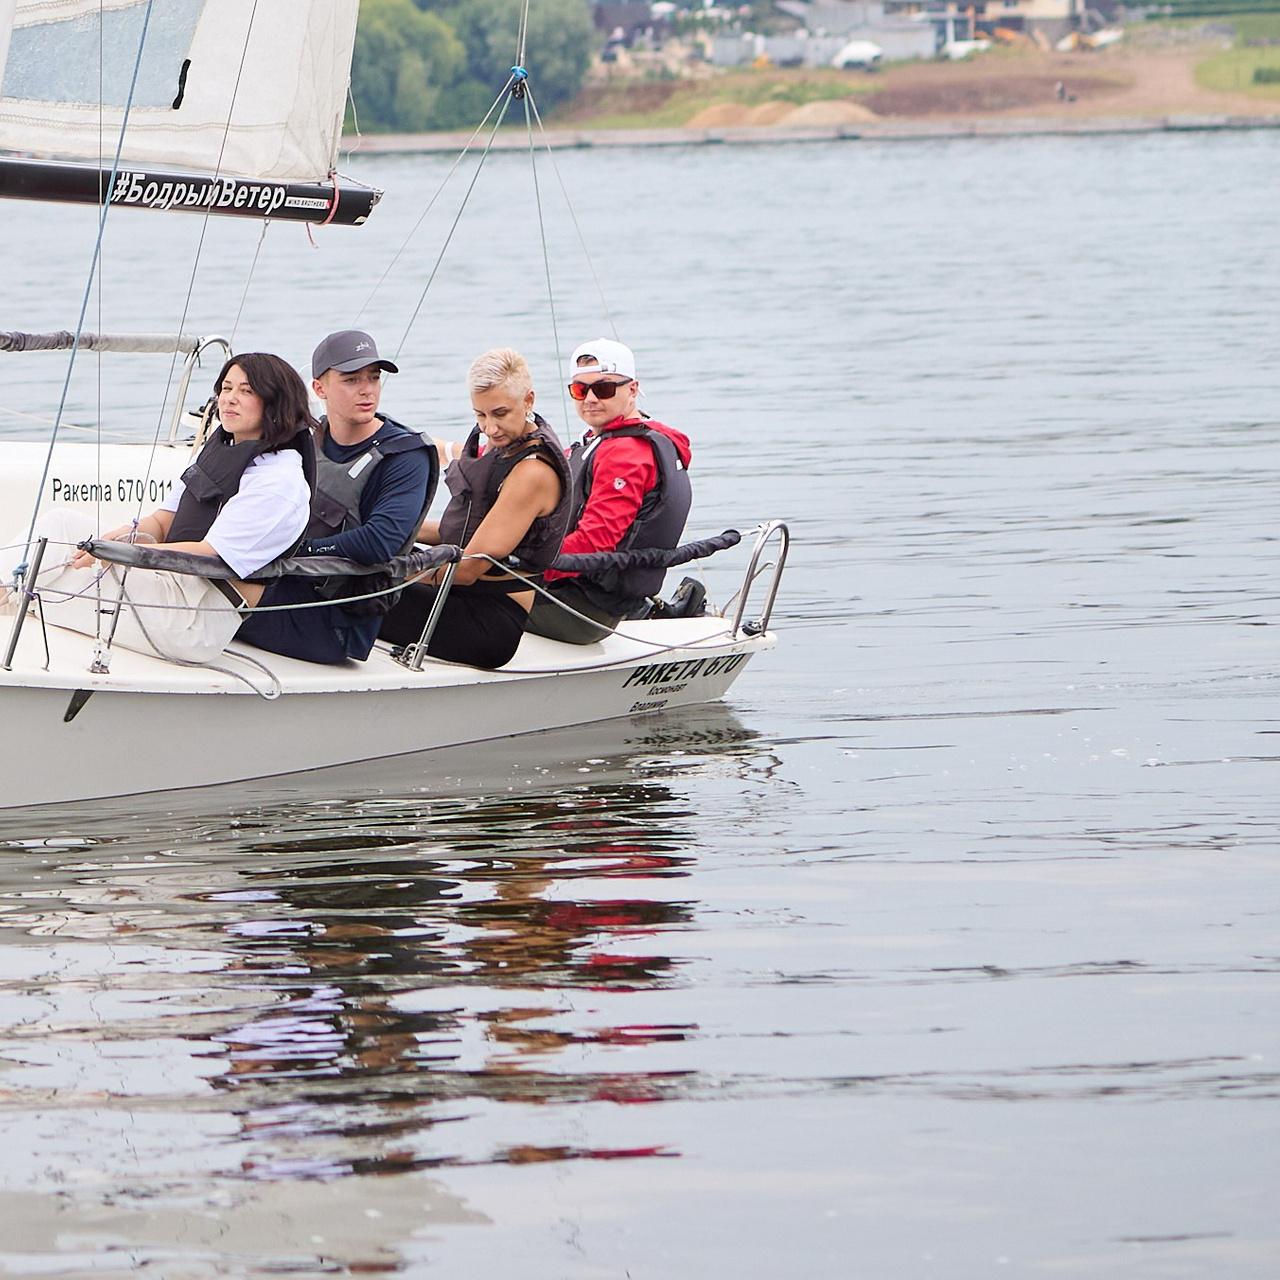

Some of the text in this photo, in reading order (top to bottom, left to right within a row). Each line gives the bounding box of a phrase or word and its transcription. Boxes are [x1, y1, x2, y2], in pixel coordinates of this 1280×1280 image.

[118, 478, 144, 502] 670
[622, 653, 746, 688] РАКЕТА 670
